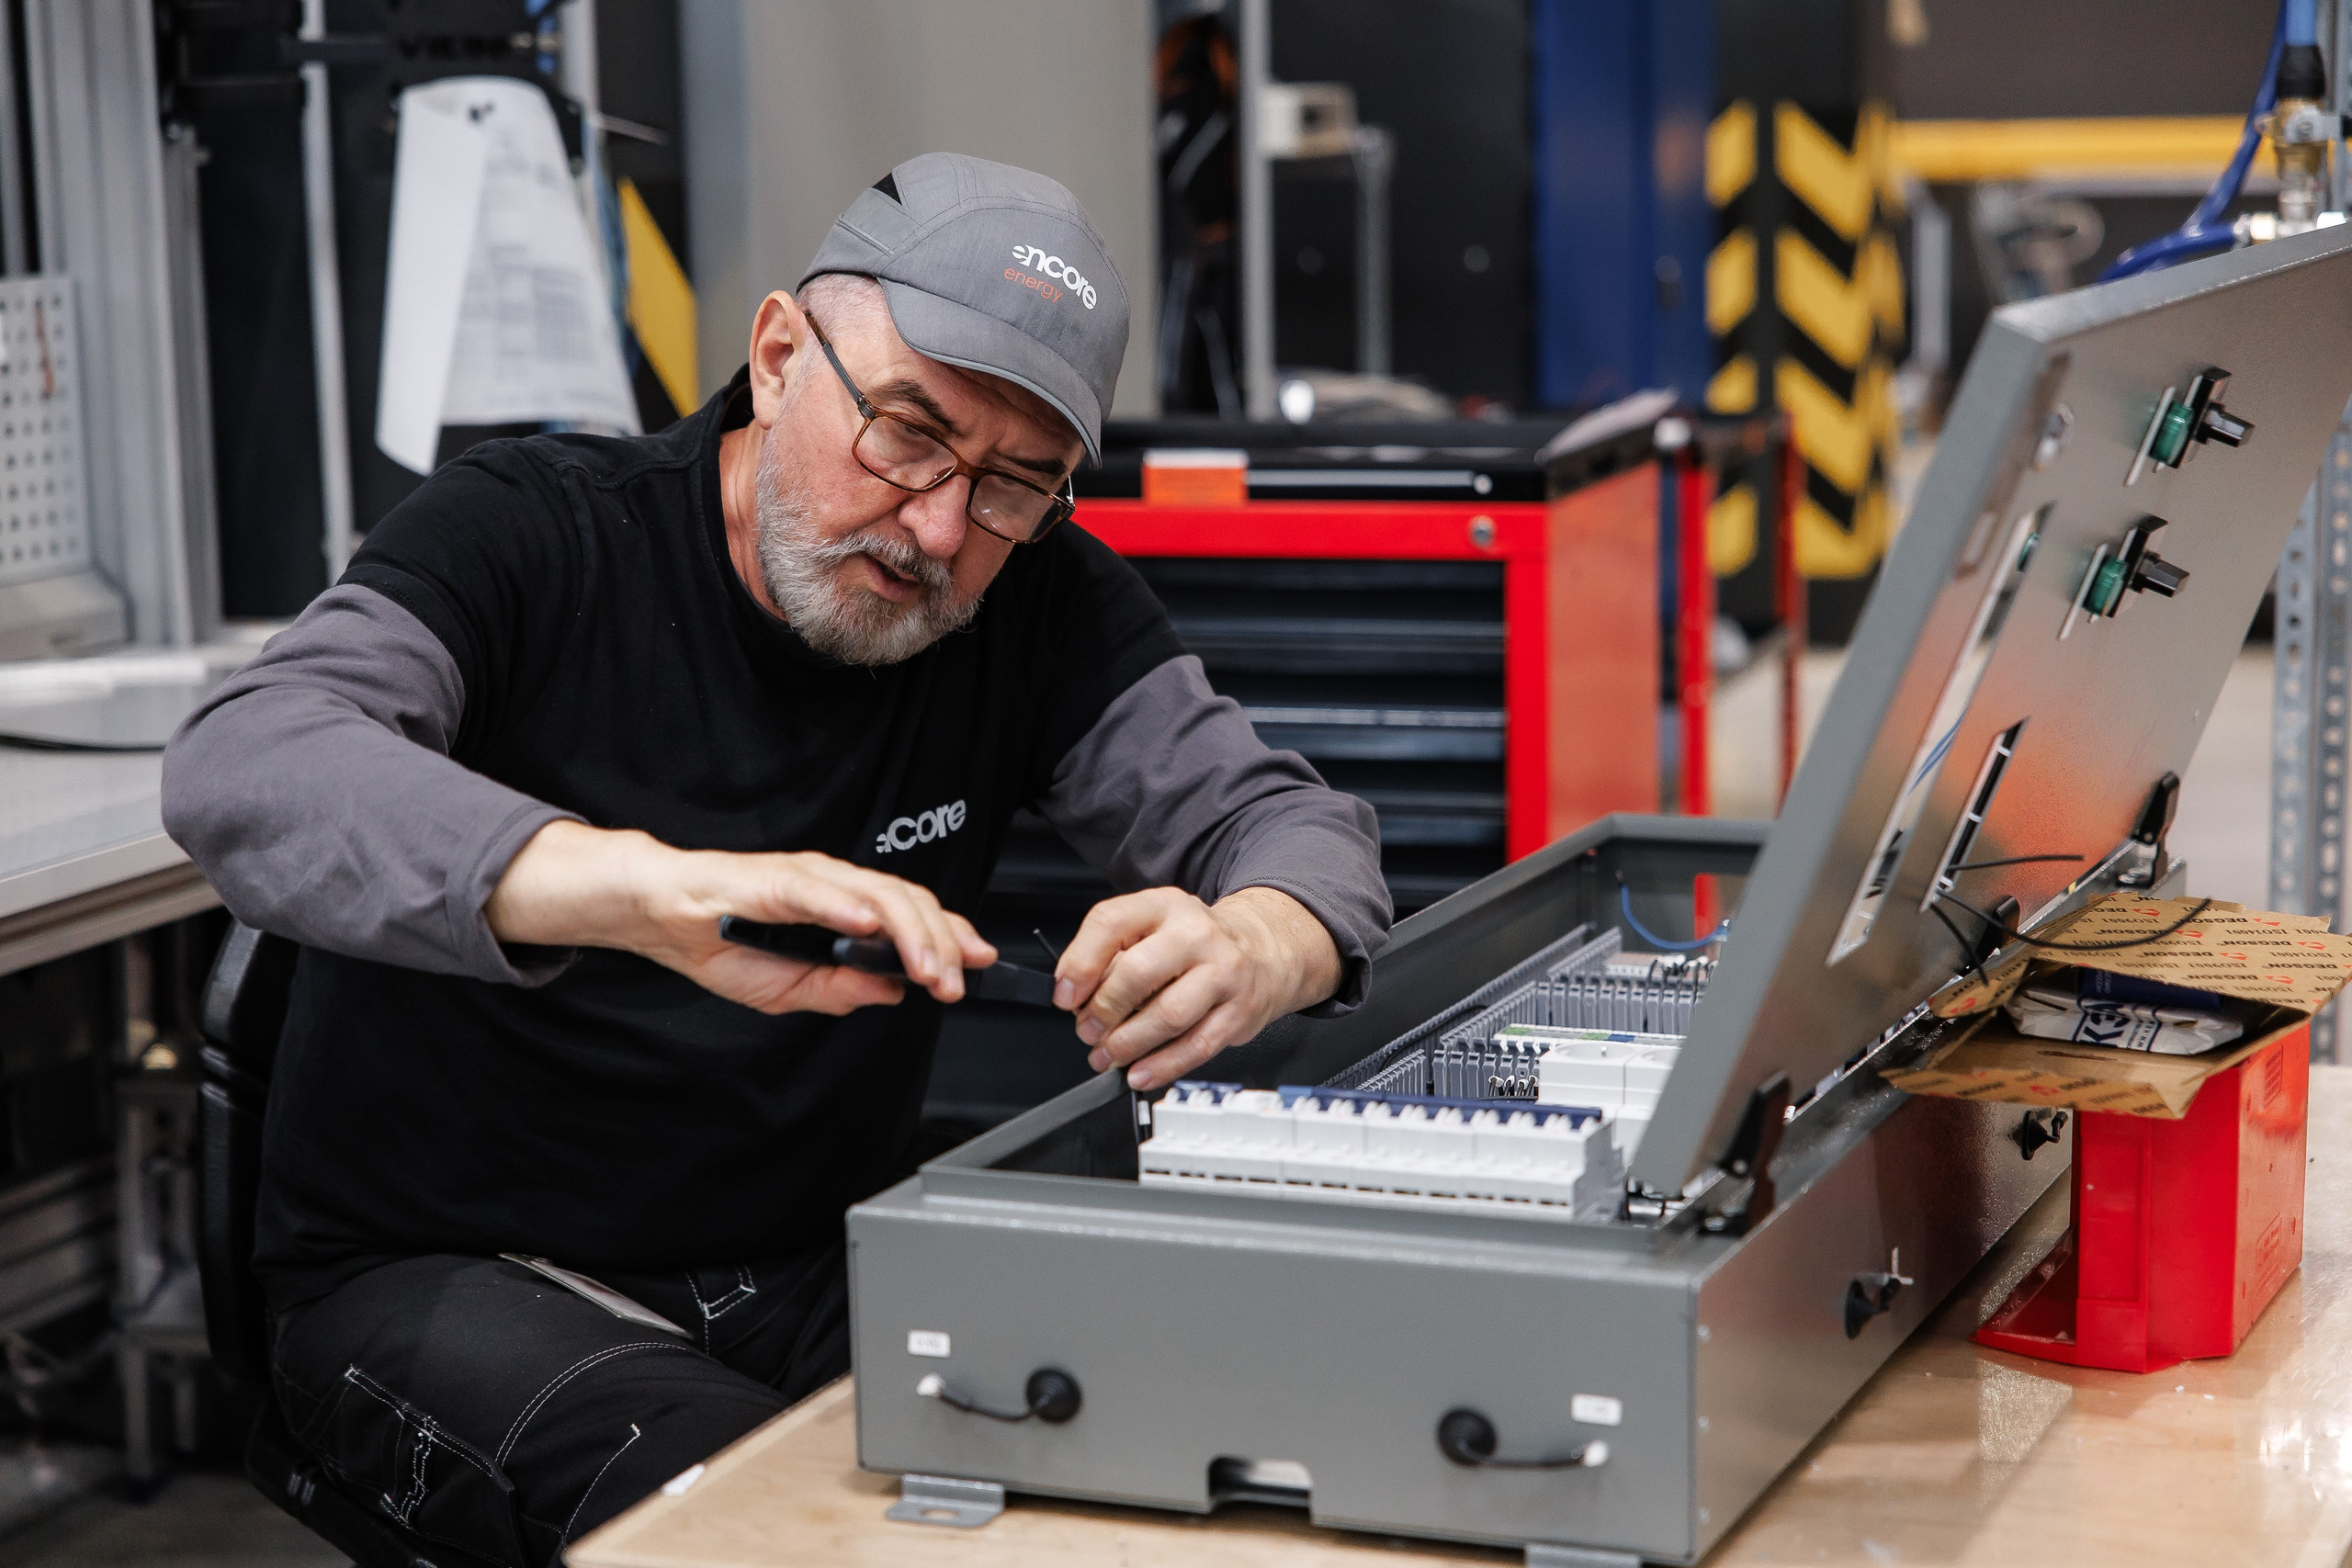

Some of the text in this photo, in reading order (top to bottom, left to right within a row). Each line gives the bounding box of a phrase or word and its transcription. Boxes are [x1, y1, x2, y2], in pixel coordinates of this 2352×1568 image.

[1004, 267, 1064, 303] energy
[1012, 244, 1097, 310] encore
[876, 798, 967, 853] ecore
